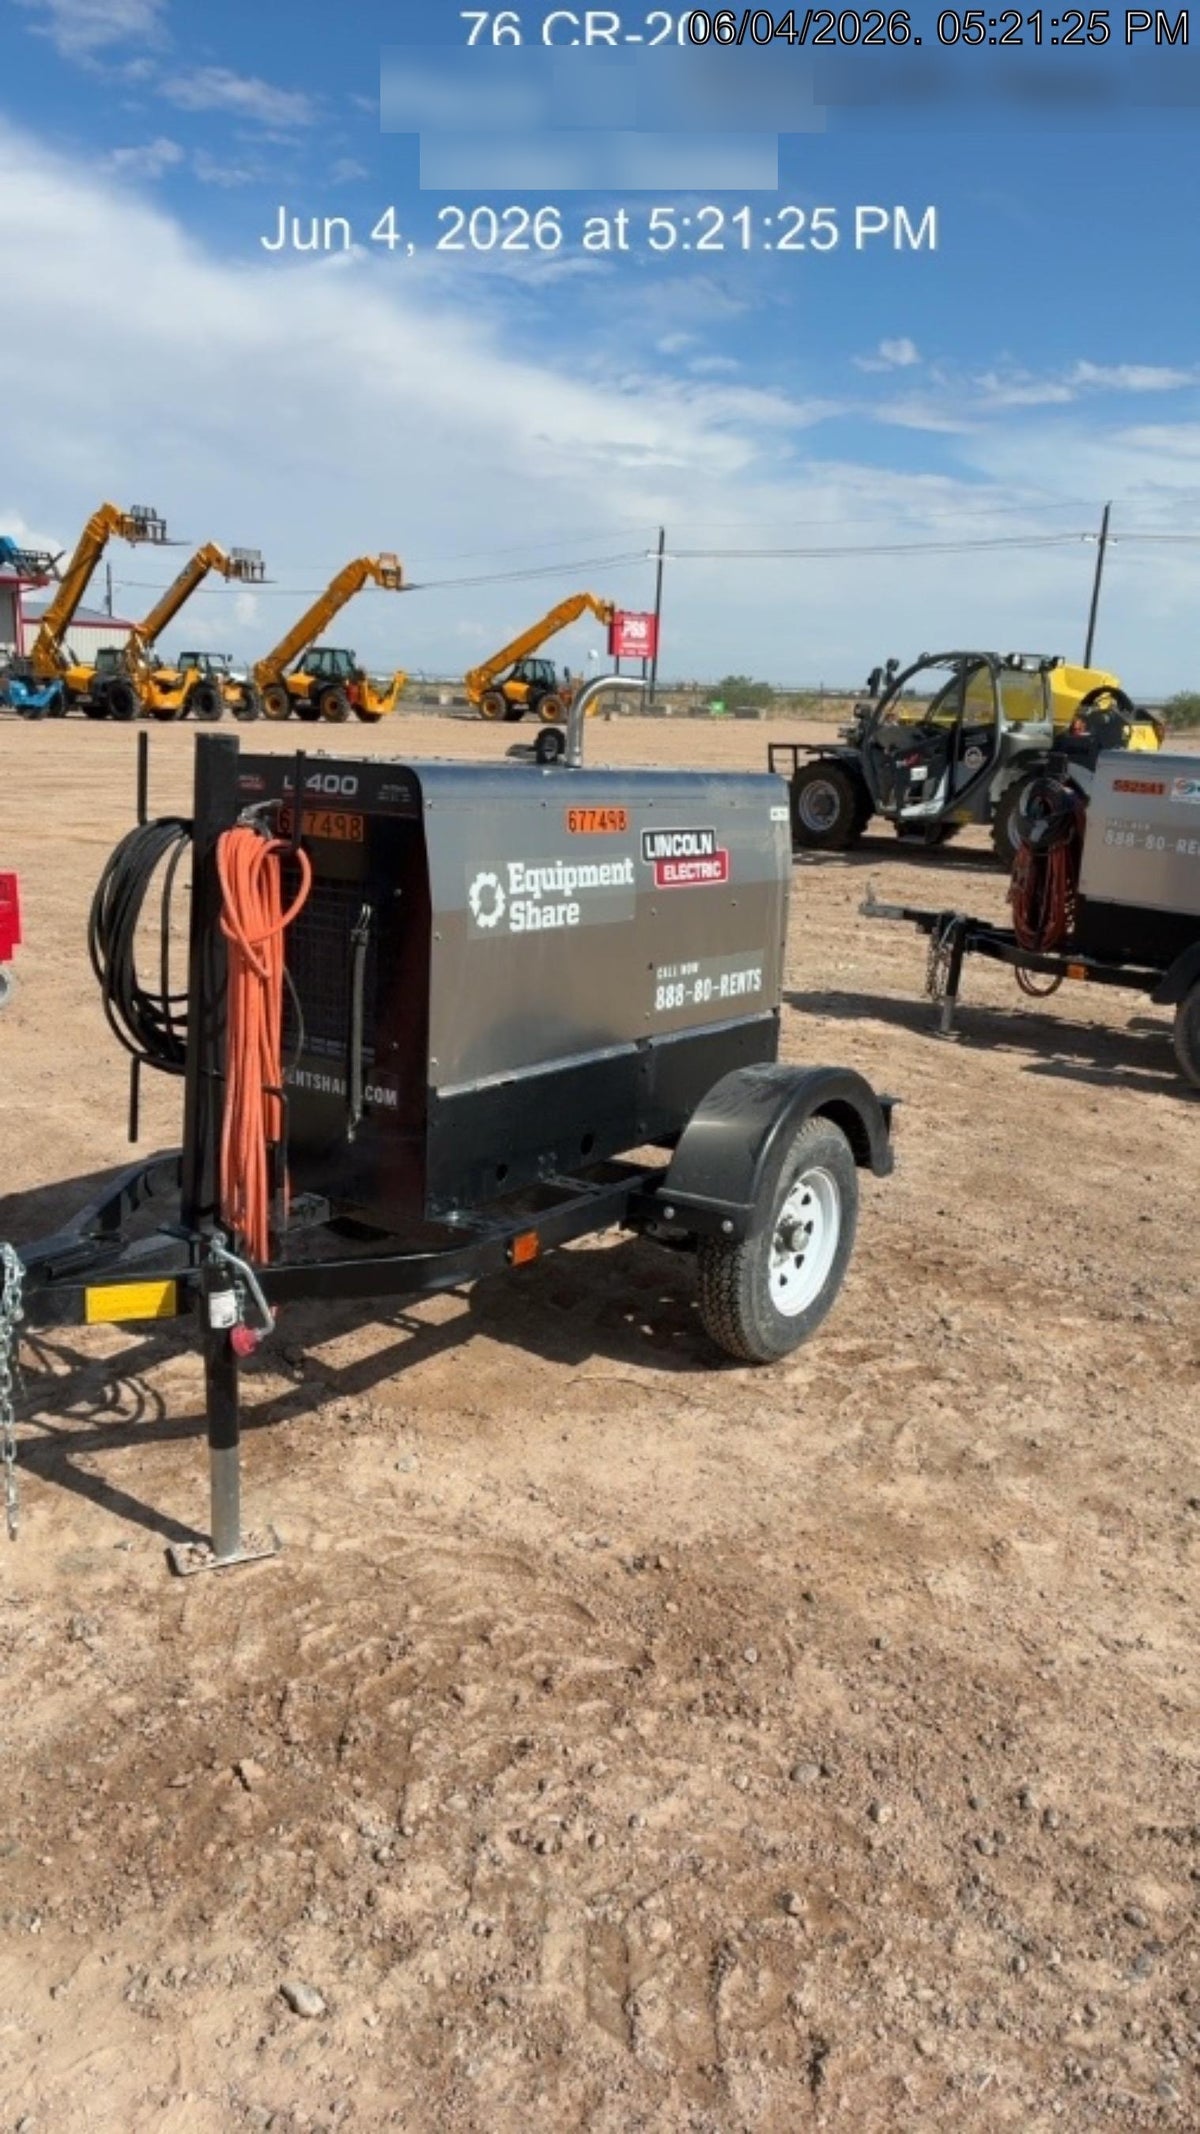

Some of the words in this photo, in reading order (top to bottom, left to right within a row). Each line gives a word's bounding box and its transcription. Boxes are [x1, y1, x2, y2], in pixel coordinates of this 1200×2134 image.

[279, 809, 363, 840] 67498
[567, 809, 627, 833] 677498
[644, 833, 714, 858] LINCOLN
[1104, 828, 1200, 857] 888-80-RE
[506, 856, 635, 900] Equipment
[662, 860, 723, 881] ELECTRIC
[508, 900, 581, 933] Share
[655, 967, 762, 1011] 888-80-RENTS
